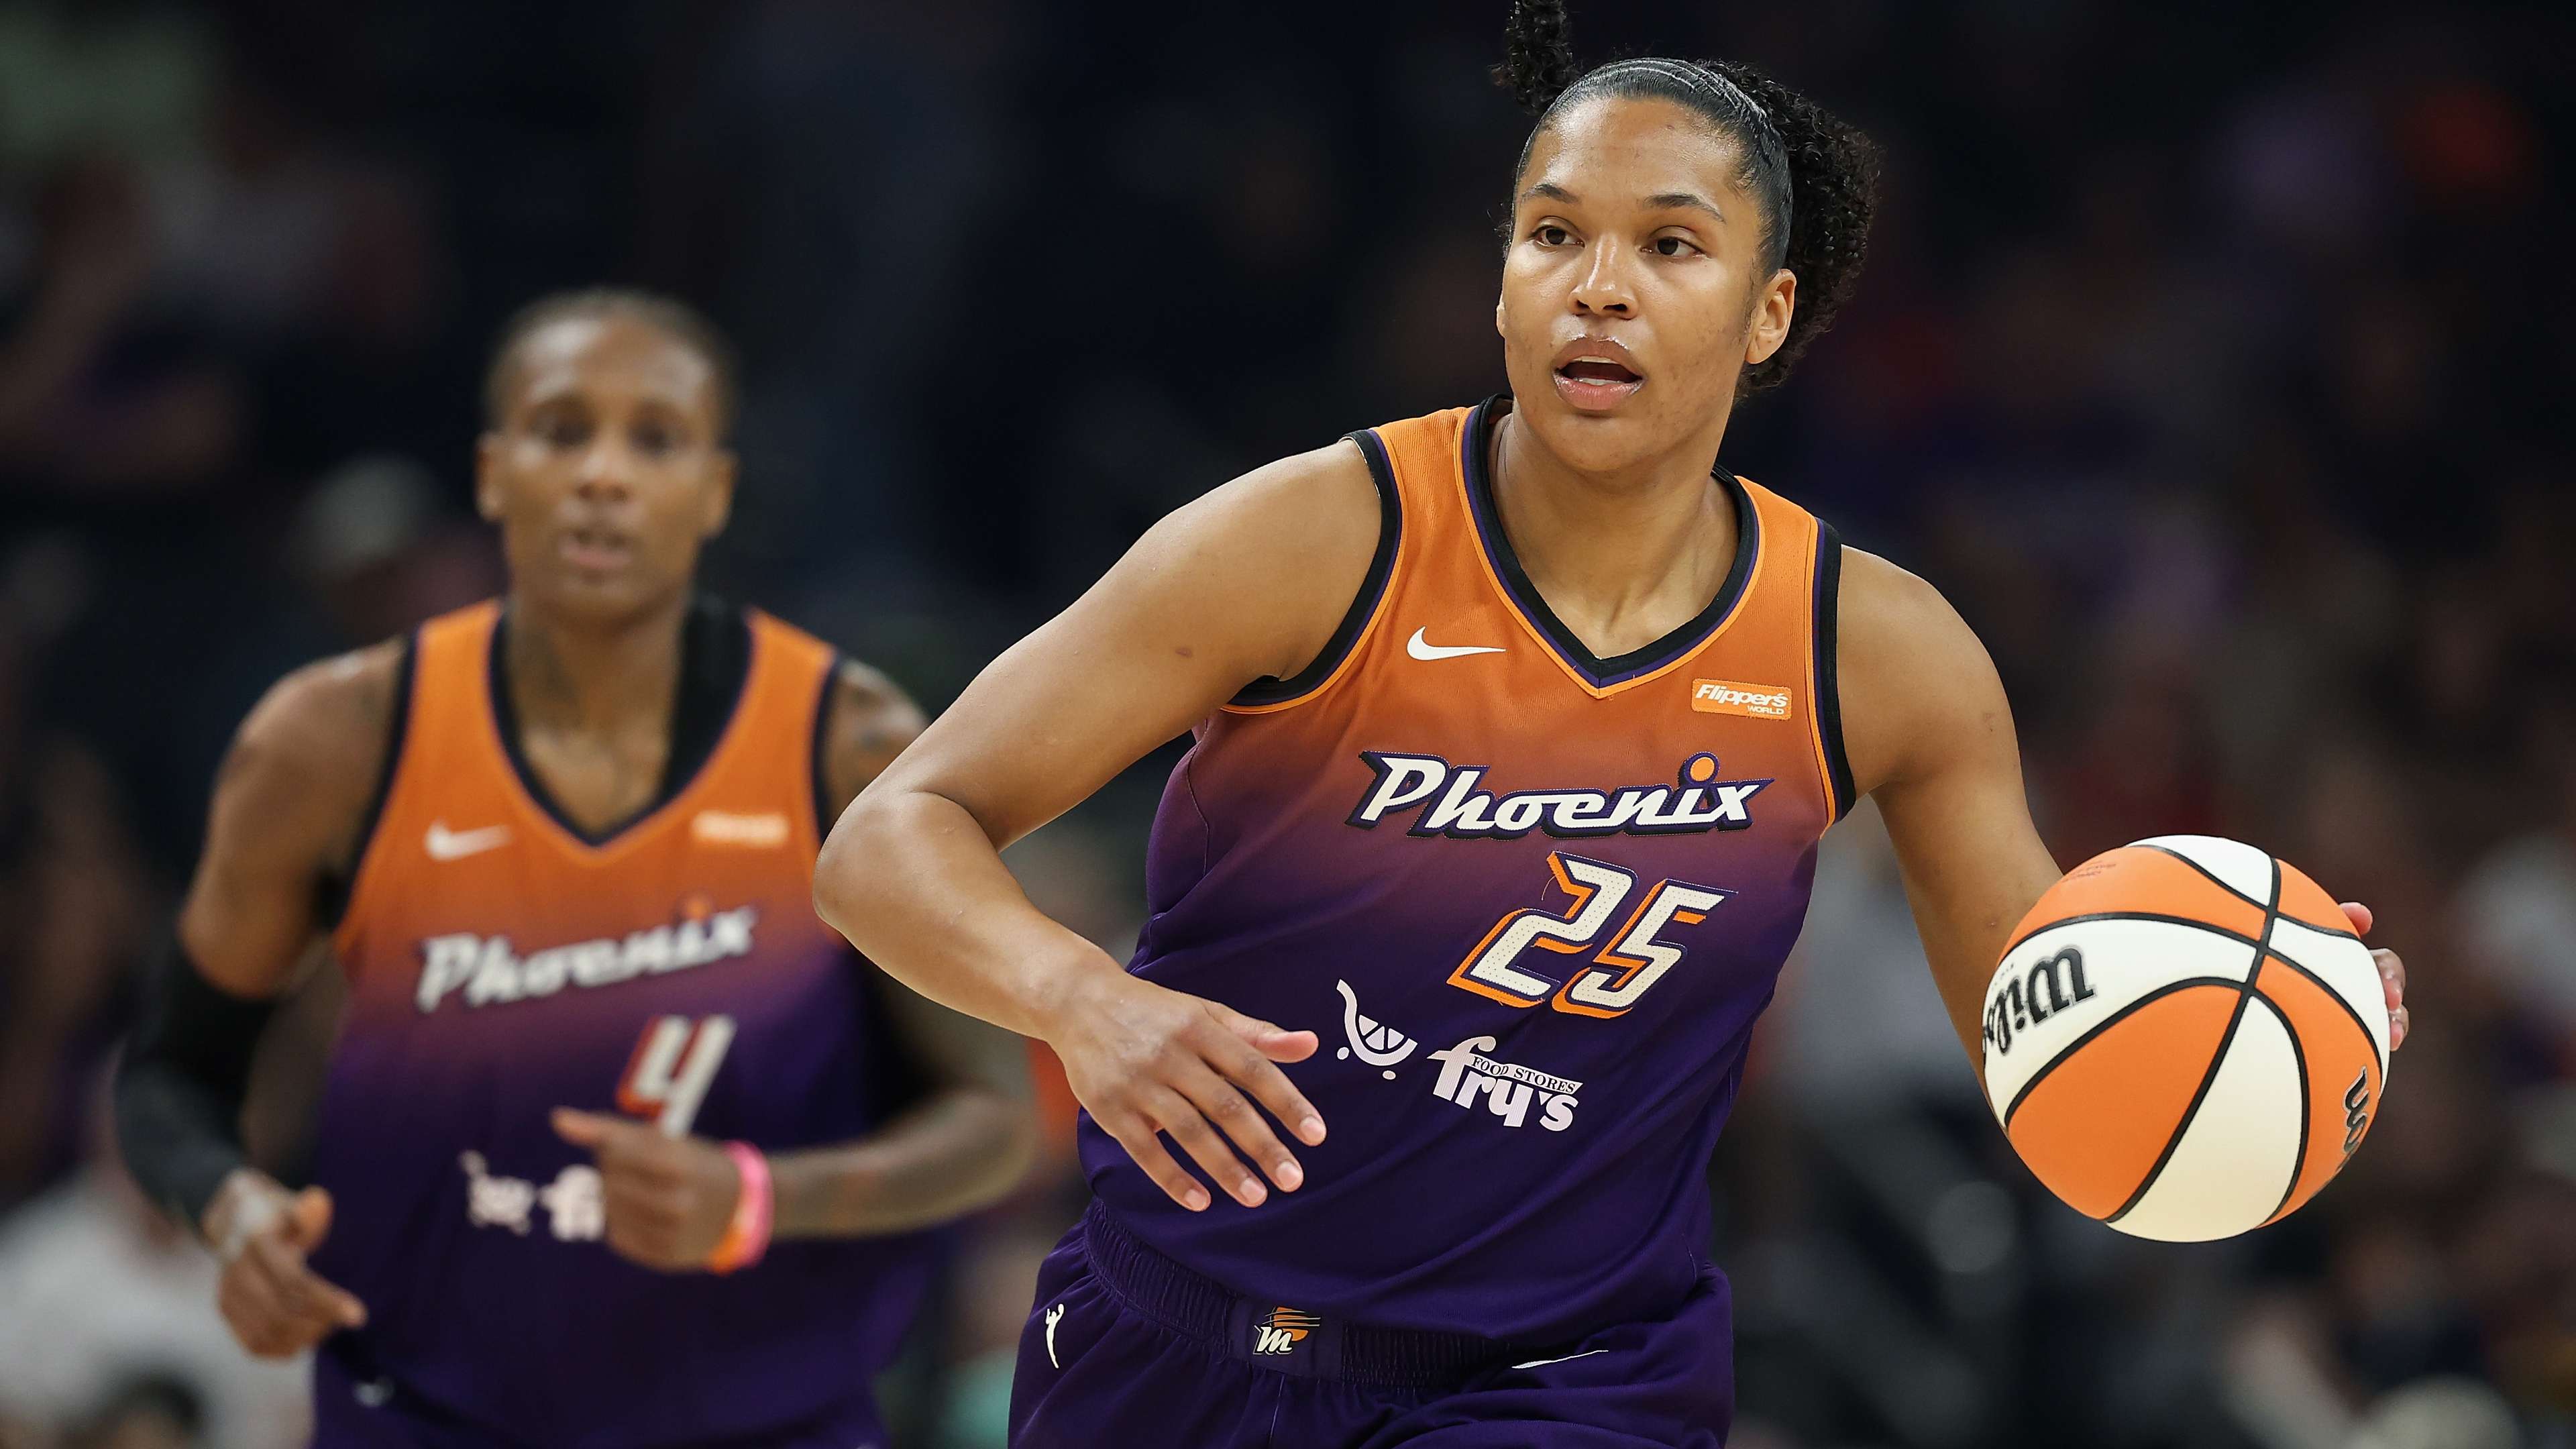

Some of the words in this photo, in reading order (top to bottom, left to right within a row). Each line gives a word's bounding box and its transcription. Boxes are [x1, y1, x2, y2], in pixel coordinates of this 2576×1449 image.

[1695, 684, 1788, 708] Flipper's
[1747, 704, 1785, 715] WORLD
[1350, 752, 1771, 837] Phoenix
[415, 896, 757, 1012] Phoenix
[1447, 852, 1737, 1018] 25
[616, 1013, 737, 1138] 4
[1427, 1036, 1579, 1132] fry's
[1471, 1056, 1509, 1077] FOOD
[1513, 1067, 1576, 1093] STORES
